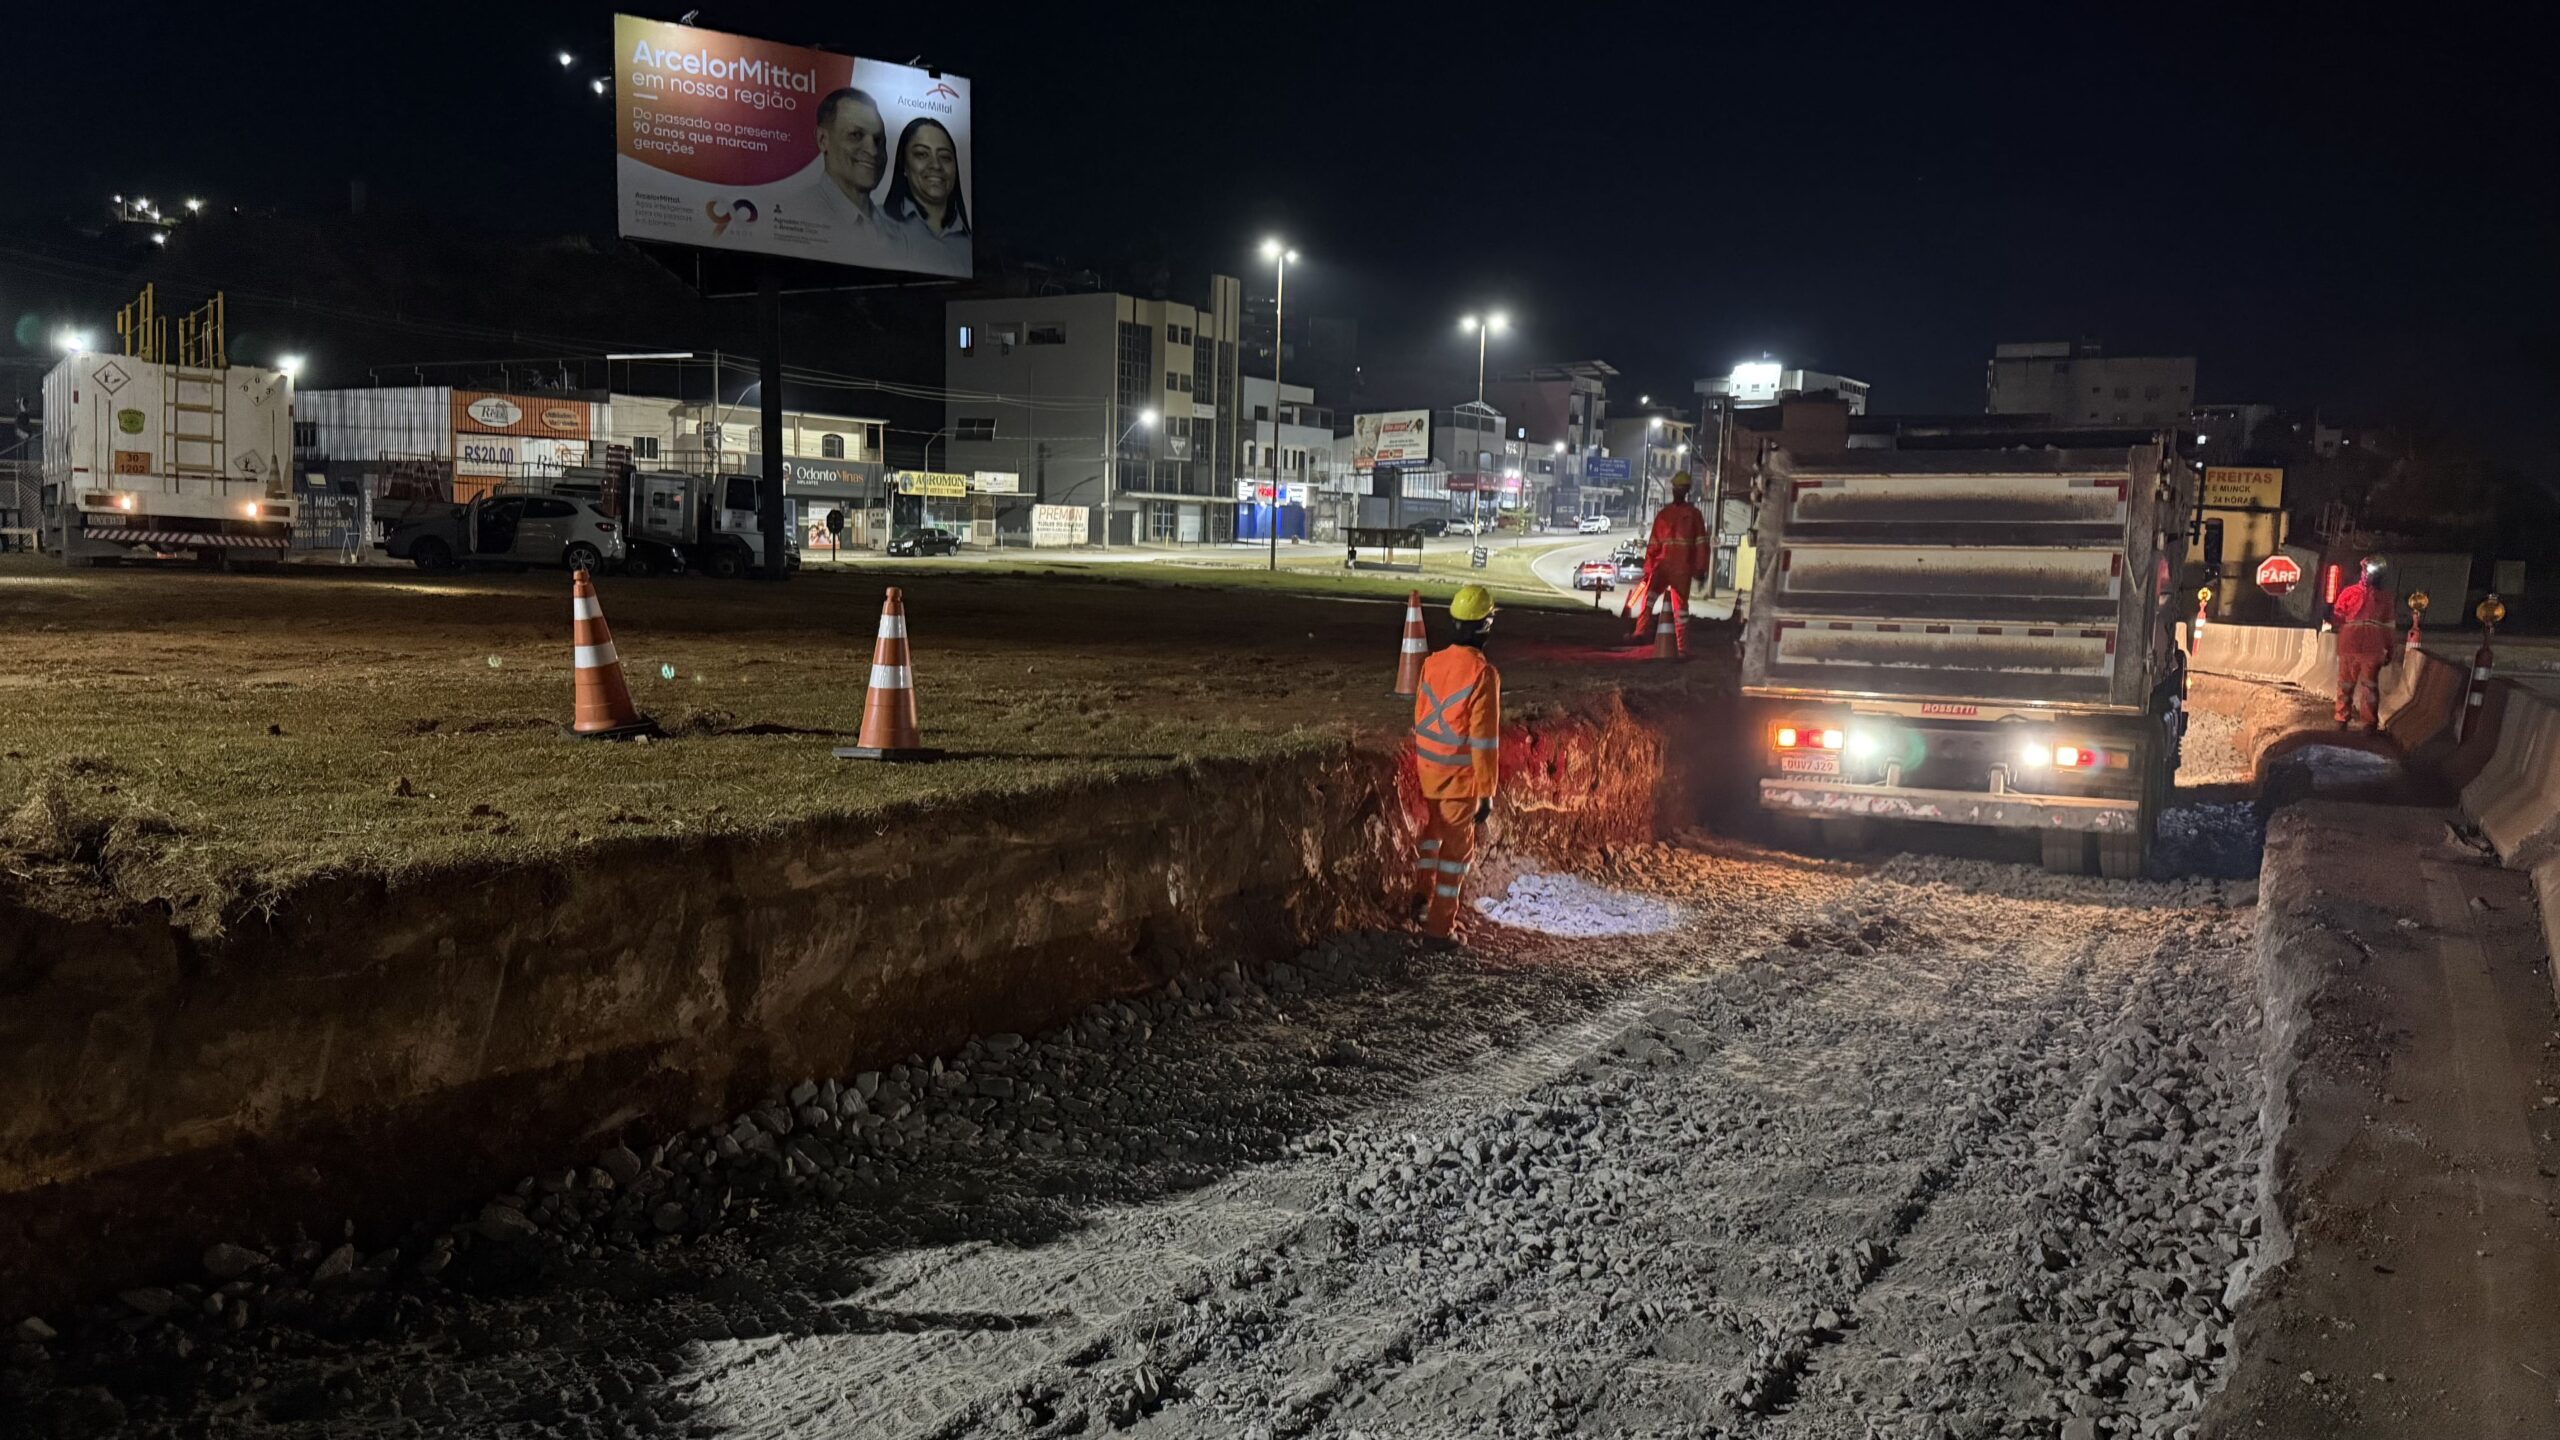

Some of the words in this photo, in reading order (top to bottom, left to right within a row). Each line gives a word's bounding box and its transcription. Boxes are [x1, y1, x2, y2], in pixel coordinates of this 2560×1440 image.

[632, 40, 816, 94] ArcelorMittal
[633, 71, 664, 90] em
[671, 77, 728, 100] nossa
[734, 87, 797, 111] região
[898, 95, 952, 114] ArcelorMittal
[633, 107, 651, 121] Do
[656, 111, 711, 131] passado
[715, 119, 732, 132] ao
[735, 124, 791, 143] presente:
[633, 121, 650, 135] 90
[654, 125, 685, 140] anos
[688, 129, 713, 145] que
[716, 135, 768, 152] marcam
[634, 137, 695, 156] gerações
[127, 454, 139, 463] 30
[464, 445, 514, 467] R$20,00
[120, 464, 145, 474] 1202
[2207, 471, 2273, 484] FREITAS
[2220, 485, 2251, 493] MUNCK
[2213, 496, 2222, 504] 24
[1923, 703, 1976, 715] ROSSETTI
